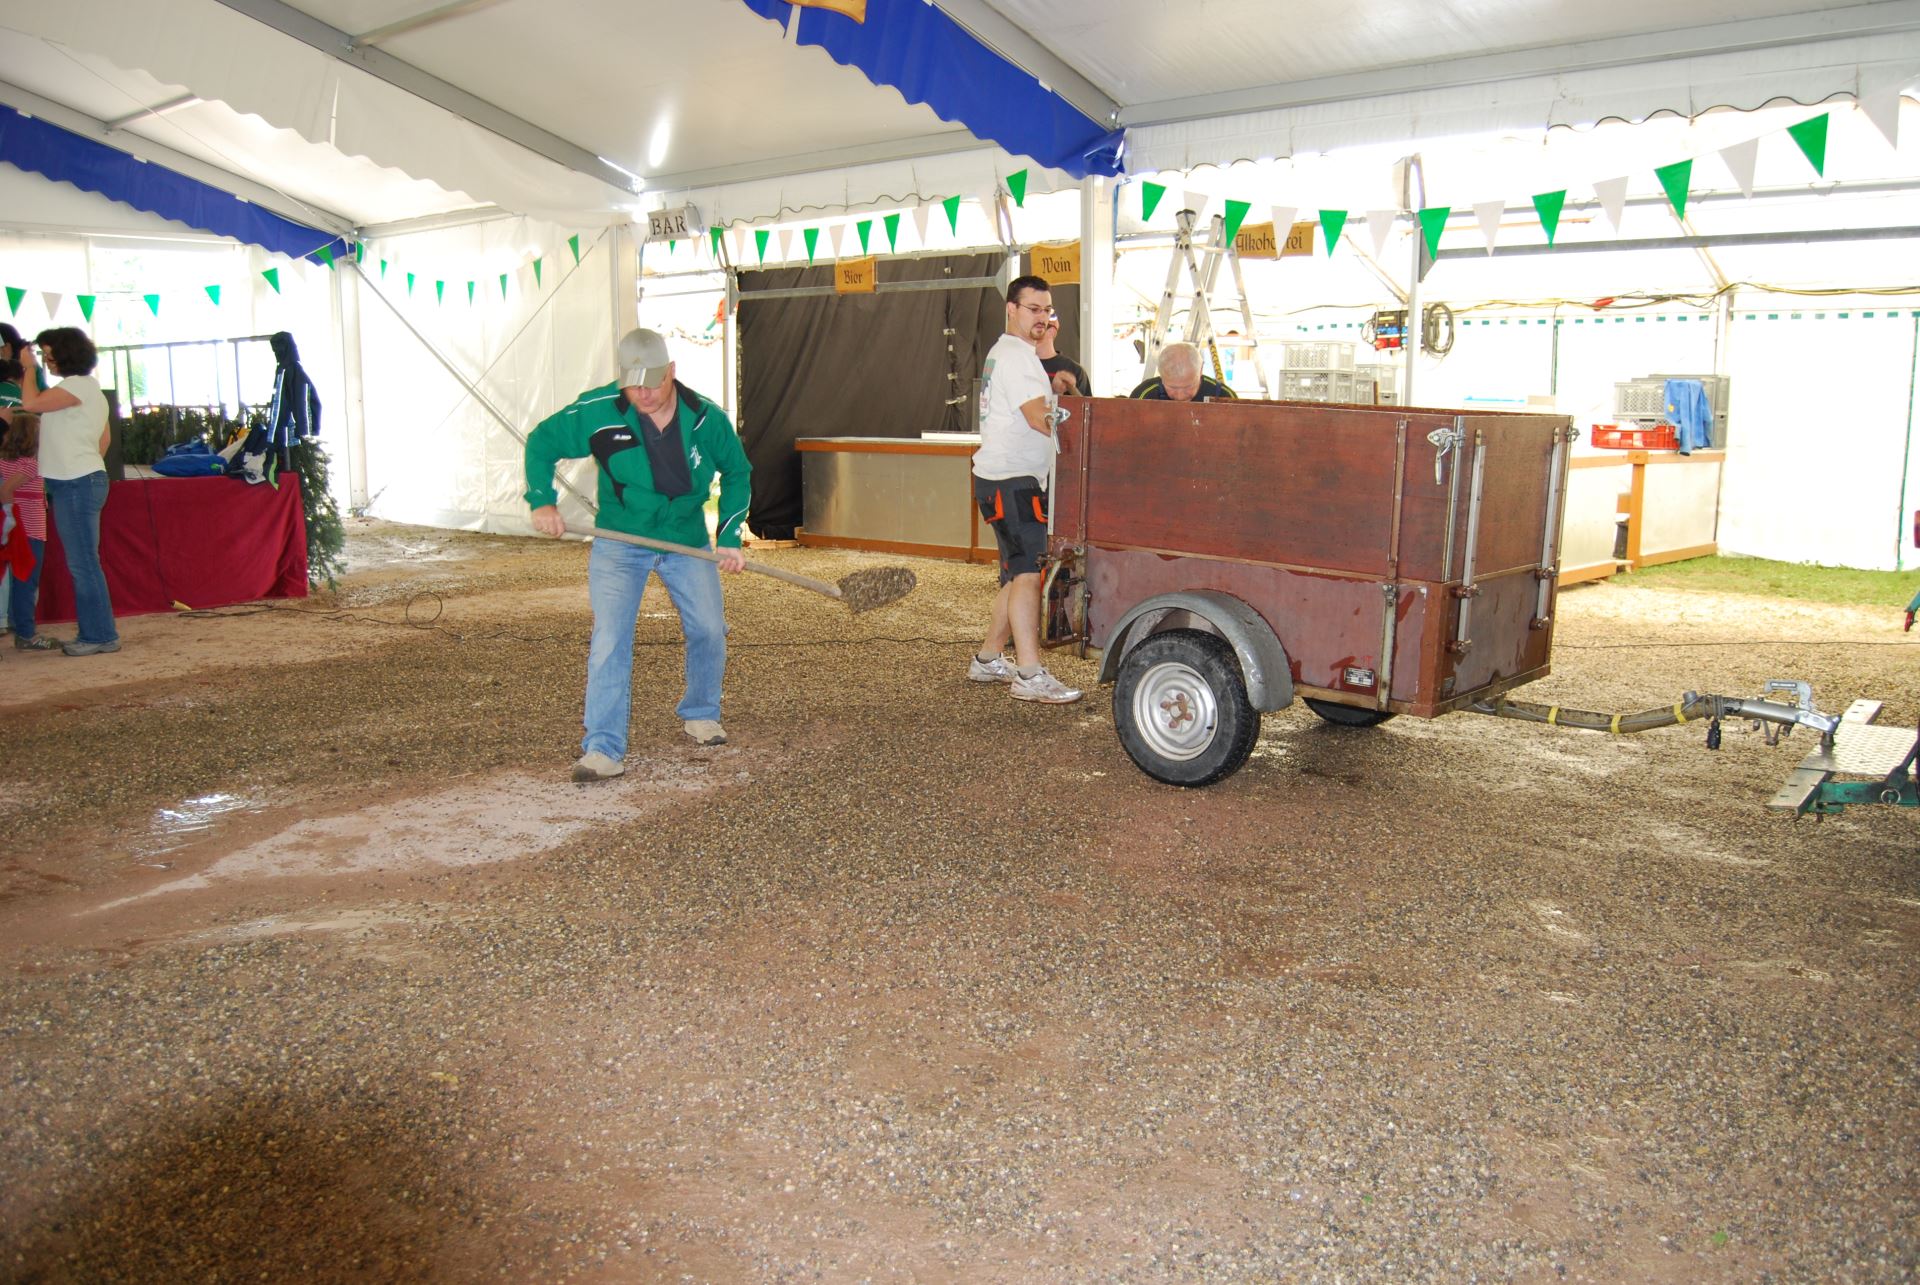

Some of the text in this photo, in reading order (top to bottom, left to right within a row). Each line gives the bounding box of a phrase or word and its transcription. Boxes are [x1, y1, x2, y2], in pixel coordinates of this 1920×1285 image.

[651, 215, 687, 235] BAR
[1236, 232, 1303, 251] Alkohorei
[1042, 256, 1071, 274] Wein
[844, 270, 863, 284] Bier
